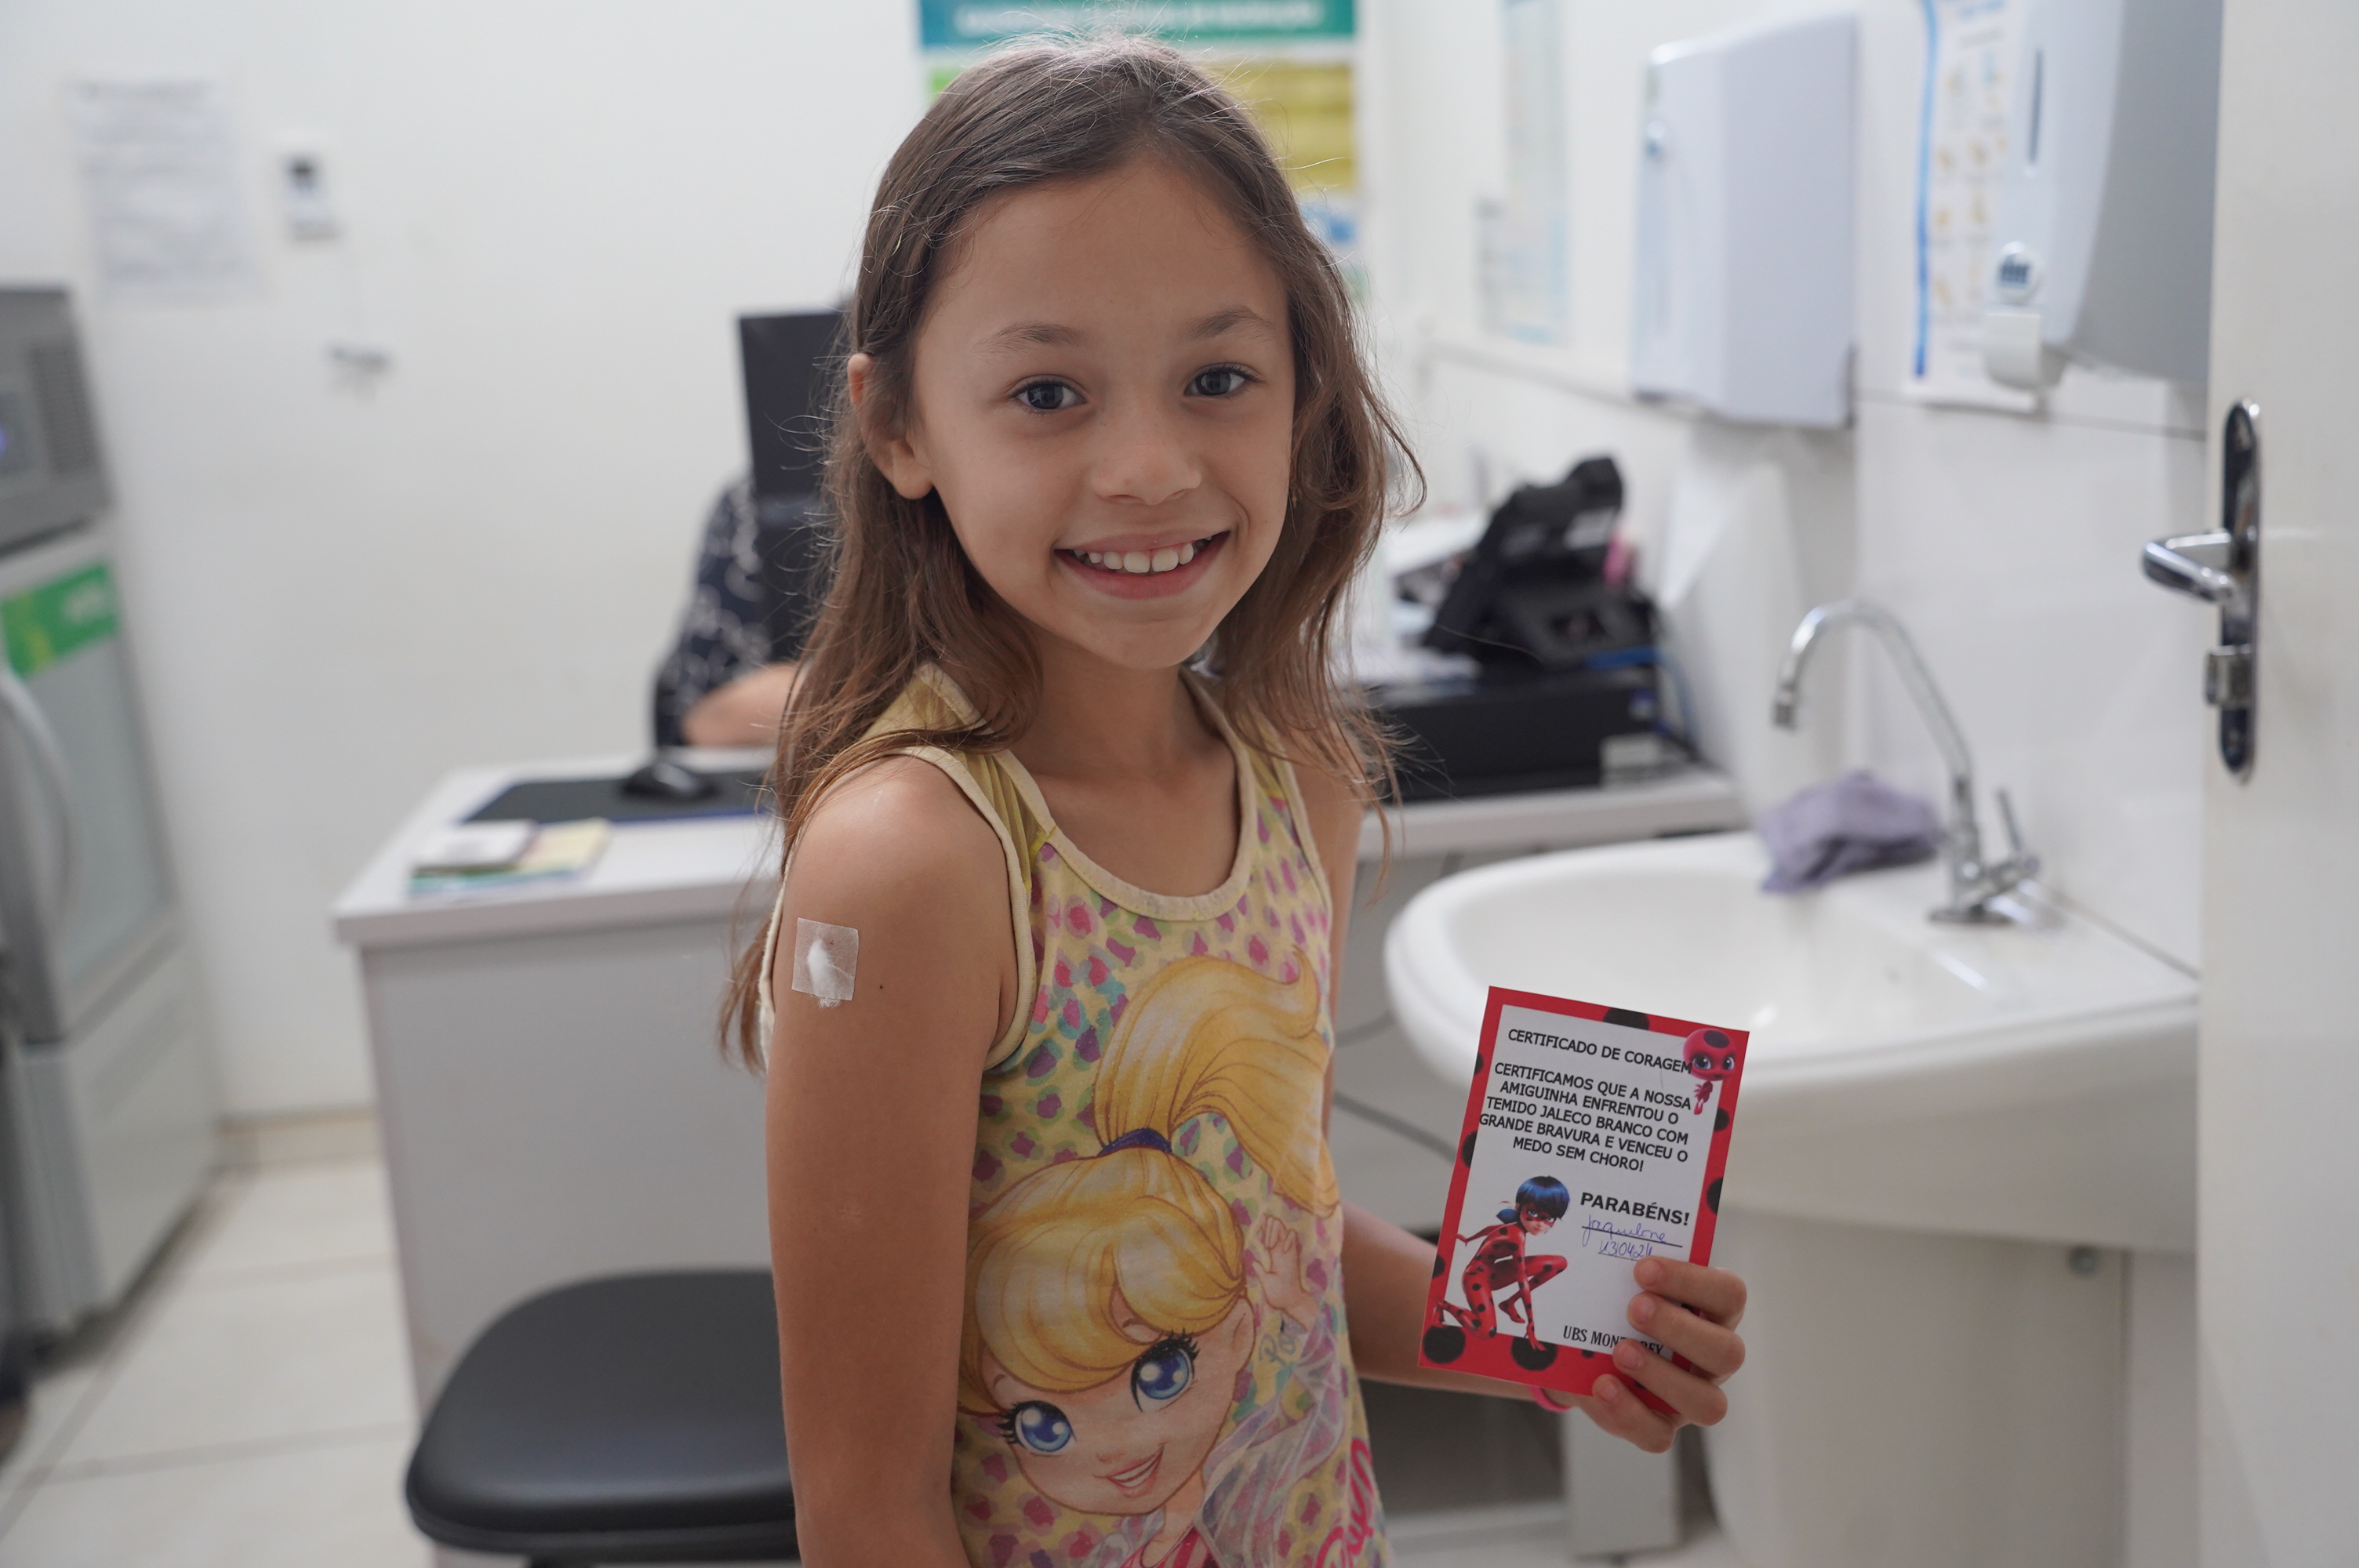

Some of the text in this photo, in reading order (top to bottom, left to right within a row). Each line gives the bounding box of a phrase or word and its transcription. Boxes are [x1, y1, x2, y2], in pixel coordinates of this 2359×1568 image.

[1508, 1029, 1692, 1074] CERTIFICADO DE CORAGEM
[1495, 1062, 1691, 1110] CERTIFICAMOS QUE A NOSSA
[1499, 1080, 1678, 1124] AMIGUINHA ENFRENTOU O
[1479, 1113, 1688, 1162] GRANDE BRAVURA E VENCEU O
[1487, 1096, 1688, 1145] TEMIDO JALECO BRANCO COM
[1513, 1136, 1644, 1172] MEDO SEM CHORO!
[1580, 1192, 1690, 1226] PARABÉNS!
[1563, 1325, 1587, 1342] UBS
